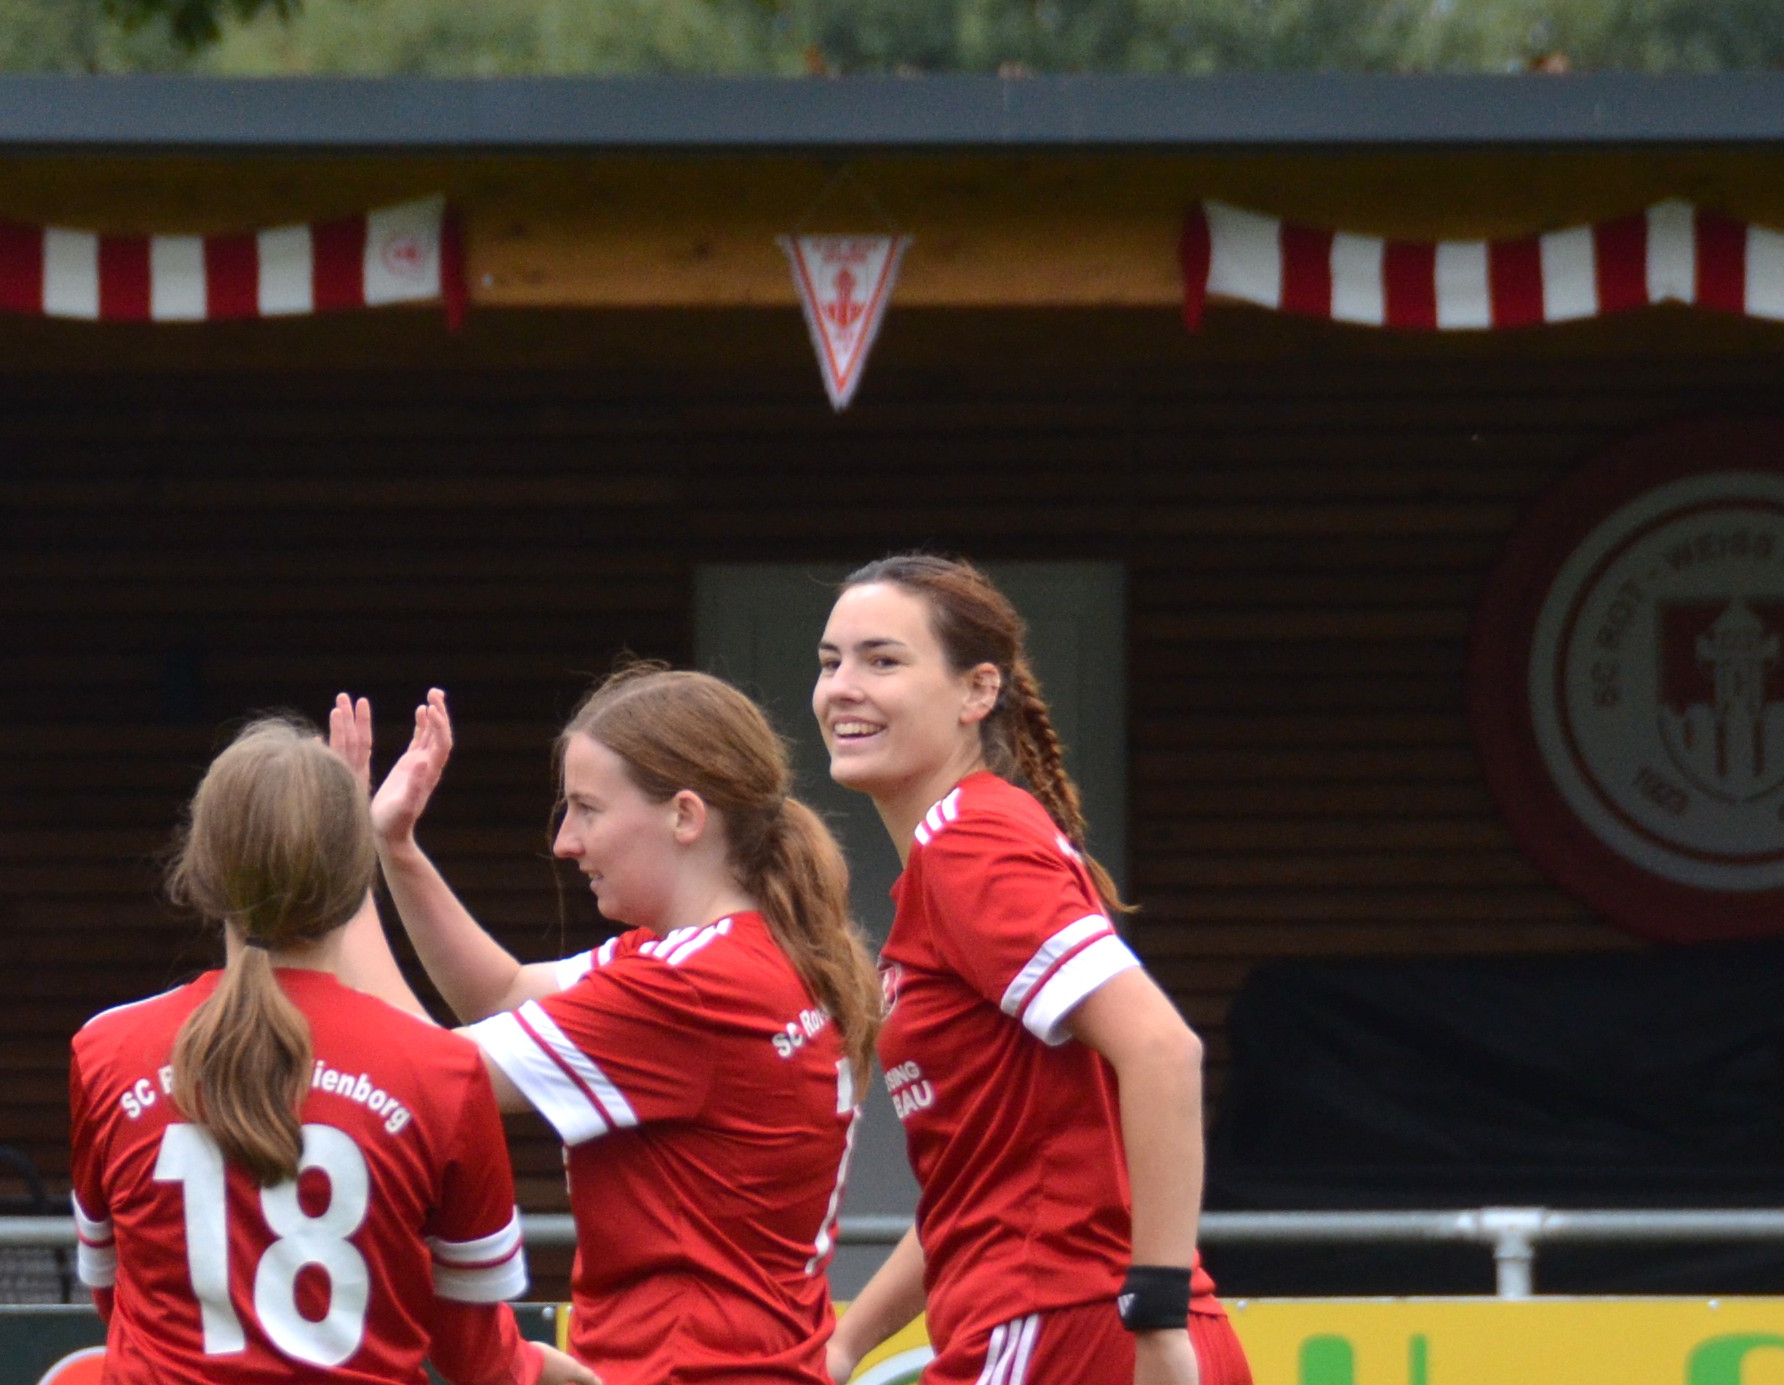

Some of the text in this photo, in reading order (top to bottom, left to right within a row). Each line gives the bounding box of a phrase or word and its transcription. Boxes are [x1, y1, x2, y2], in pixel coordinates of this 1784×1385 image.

[772, 1022, 804, 1058] SC
[120, 1078, 156, 1119] SC
[311, 1060, 410, 1134] ienborg
[153, 1123, 368, 1367] 18
